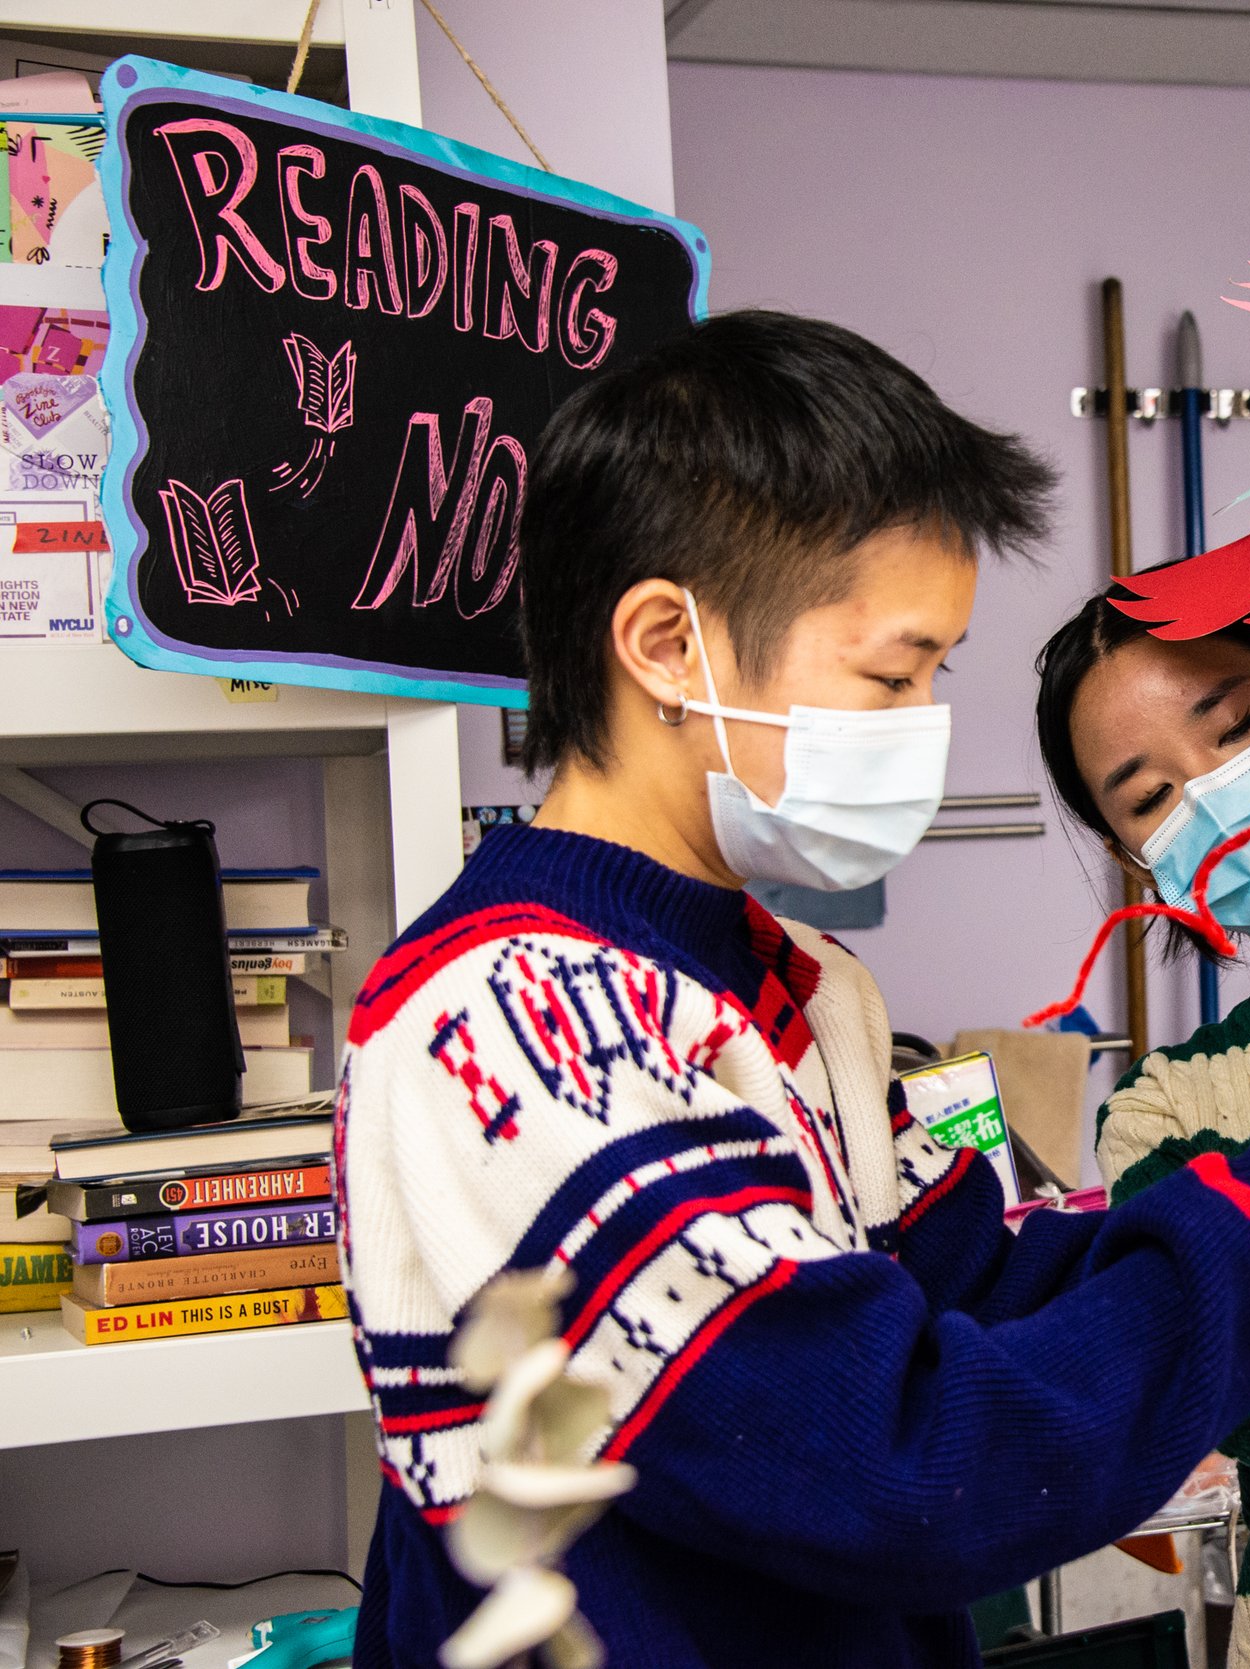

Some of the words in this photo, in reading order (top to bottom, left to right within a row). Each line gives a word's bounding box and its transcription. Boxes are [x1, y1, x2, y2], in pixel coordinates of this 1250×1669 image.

[153, 118, 617, 370] READING
[19, 398, 60, 420] Zine
[33, 411, 62, 428] Club
[21, 454, 98, 471] SLOW
[22, 473, 100, 490] DOWN
[351, 397, 527, 620] NO
[9, 601, 39, 610] NEW
[0, 611, 31, 621] TATE
[49, 618, 94, 631] NYCLU
[231, 957, 293, 972] boygenius
[165, 1186, 183, 1203] 451
[193, 1171, 305, 1204] FAHRENHEIT
[139, 1227, 158, 1254] AC
[157, 1225, 174, 1254] LEV
[196, 1215, 287, 1249] HOUSE
[290, 1256, 327, 1271] Eyre
[183, 1269, 266, 1286] CHARLOTTE
[97, 1316, 128, 1333] ED
[136, 1311, 173, 1329] LIN
[181, 1307, 214, 1324] THIS
[219, 1305, 233, 1319] IS
[238, 1304, 248, 1317] A
[253, 1300, 290, 1316] BUST
